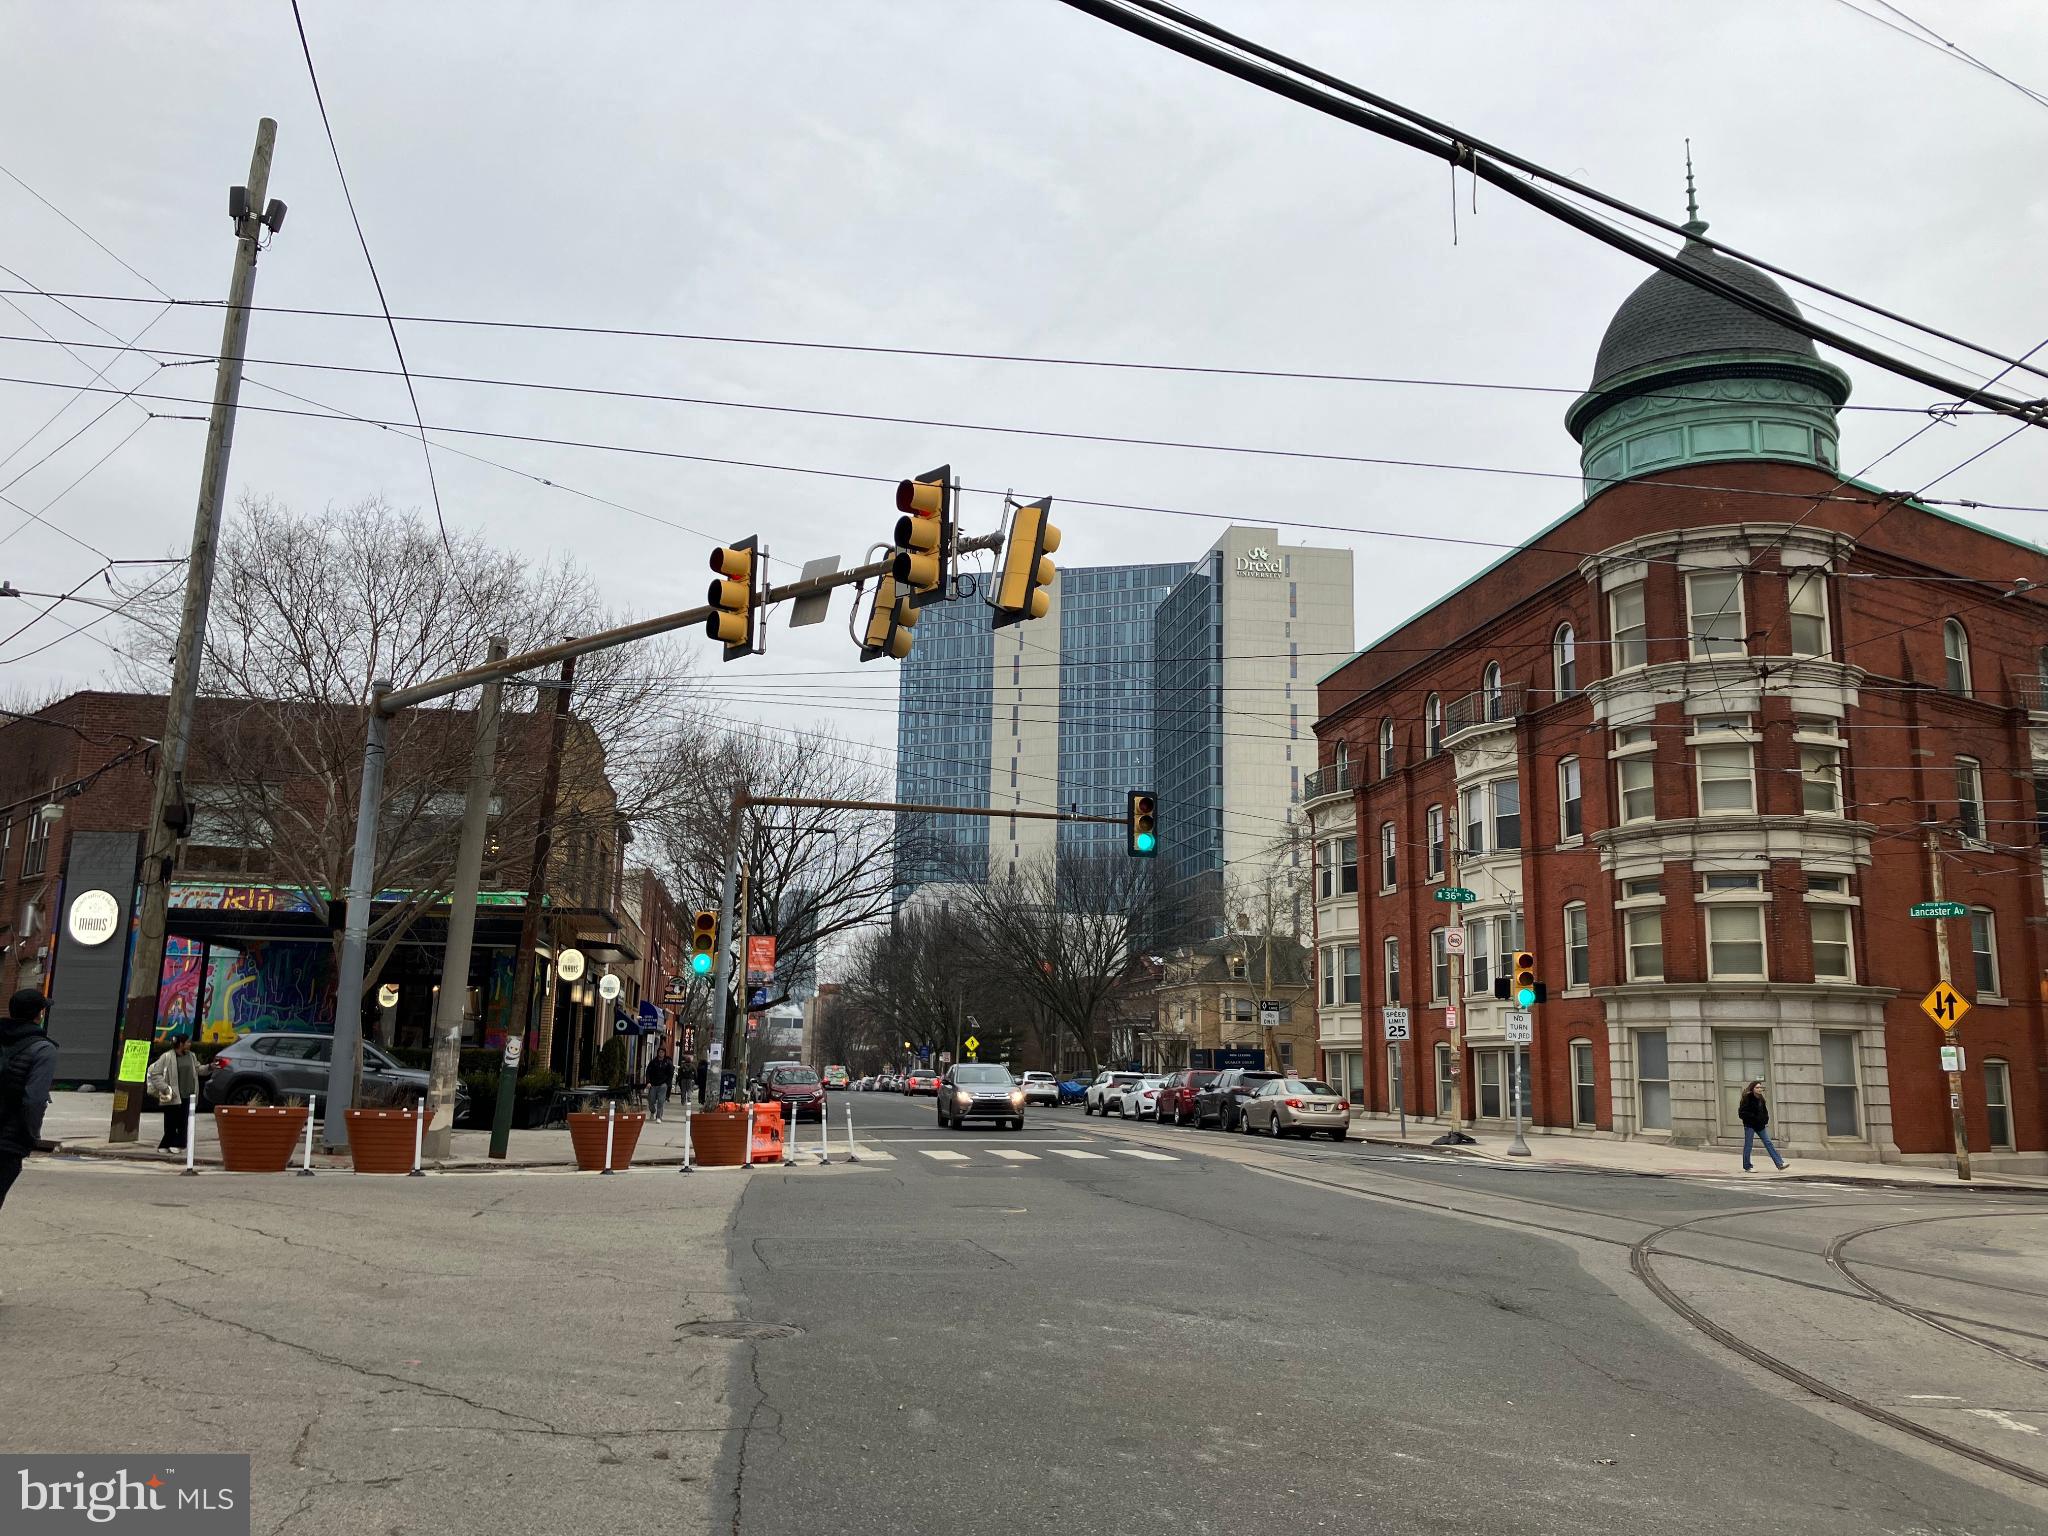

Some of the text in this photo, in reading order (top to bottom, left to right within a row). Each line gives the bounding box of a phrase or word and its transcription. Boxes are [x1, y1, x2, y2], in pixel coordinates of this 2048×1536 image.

[1236, 557, 1282, 572] Drexel
[1465, 893, 1474, 902] St
[1910, 906, 1965, 917] Lancaster Av
[1388, 1025, 1407, 1037] 25
[1510, 1023, 1528, 1031] TURN
[1518, 1032, 1530, 1040] RED
